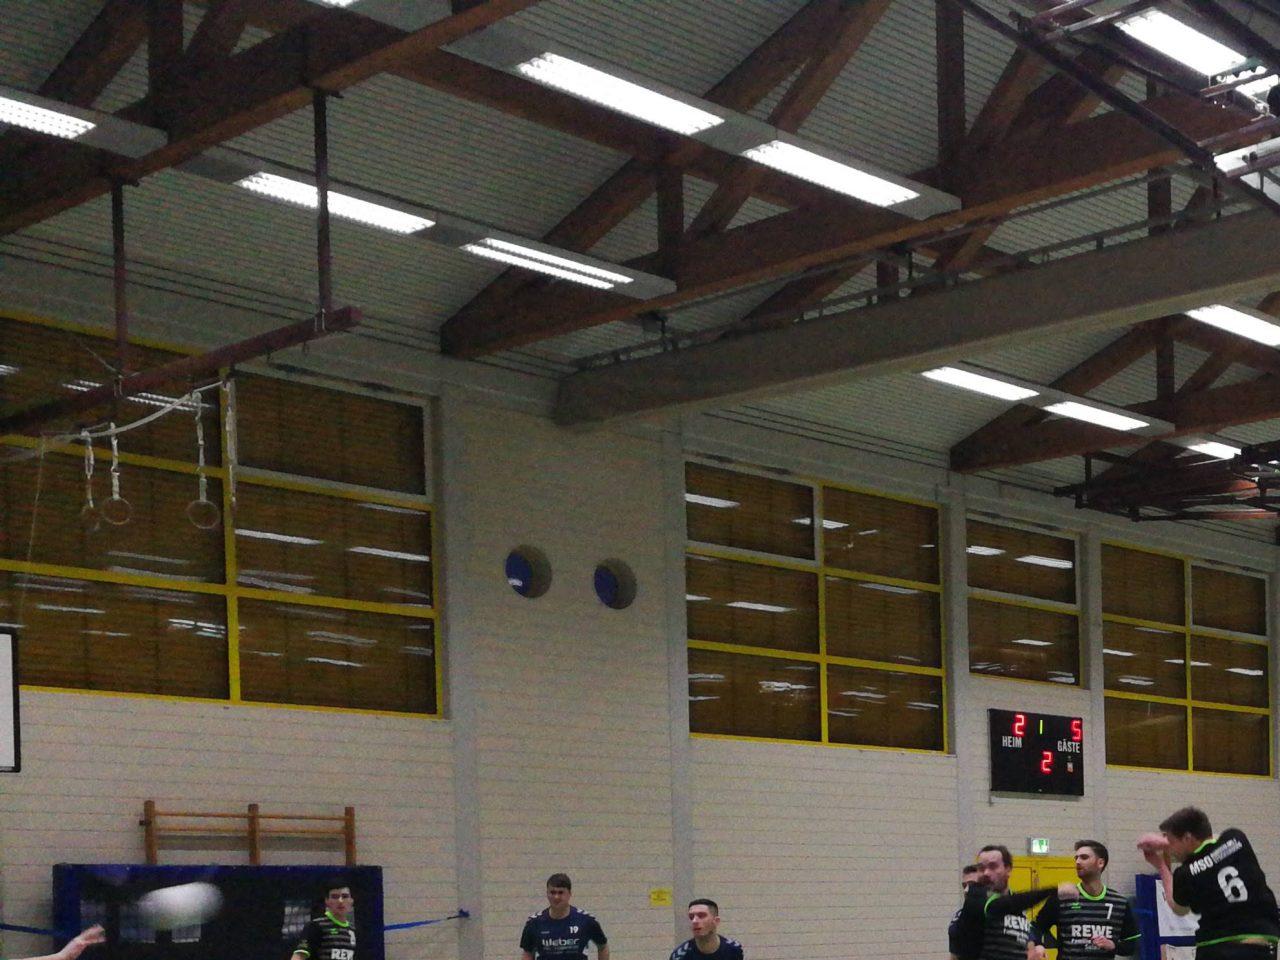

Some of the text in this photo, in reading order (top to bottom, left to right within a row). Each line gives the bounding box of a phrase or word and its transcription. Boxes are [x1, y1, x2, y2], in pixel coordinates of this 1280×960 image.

[1070, 719, 1081, 741] 5
[1002, 736, 1022, 748] HEIM
[1057, 739, 1081, 753] GÄSTE
[1041, 751, 1053, 772] 2
[1189, 855, 1214, 876] MSO
[1217, 866, 1248, 903] 6
[1105, 903, 1114, 919] 7
[569, 926, 579, 934] 19
[1071, 924, 1113, 938] REWE
